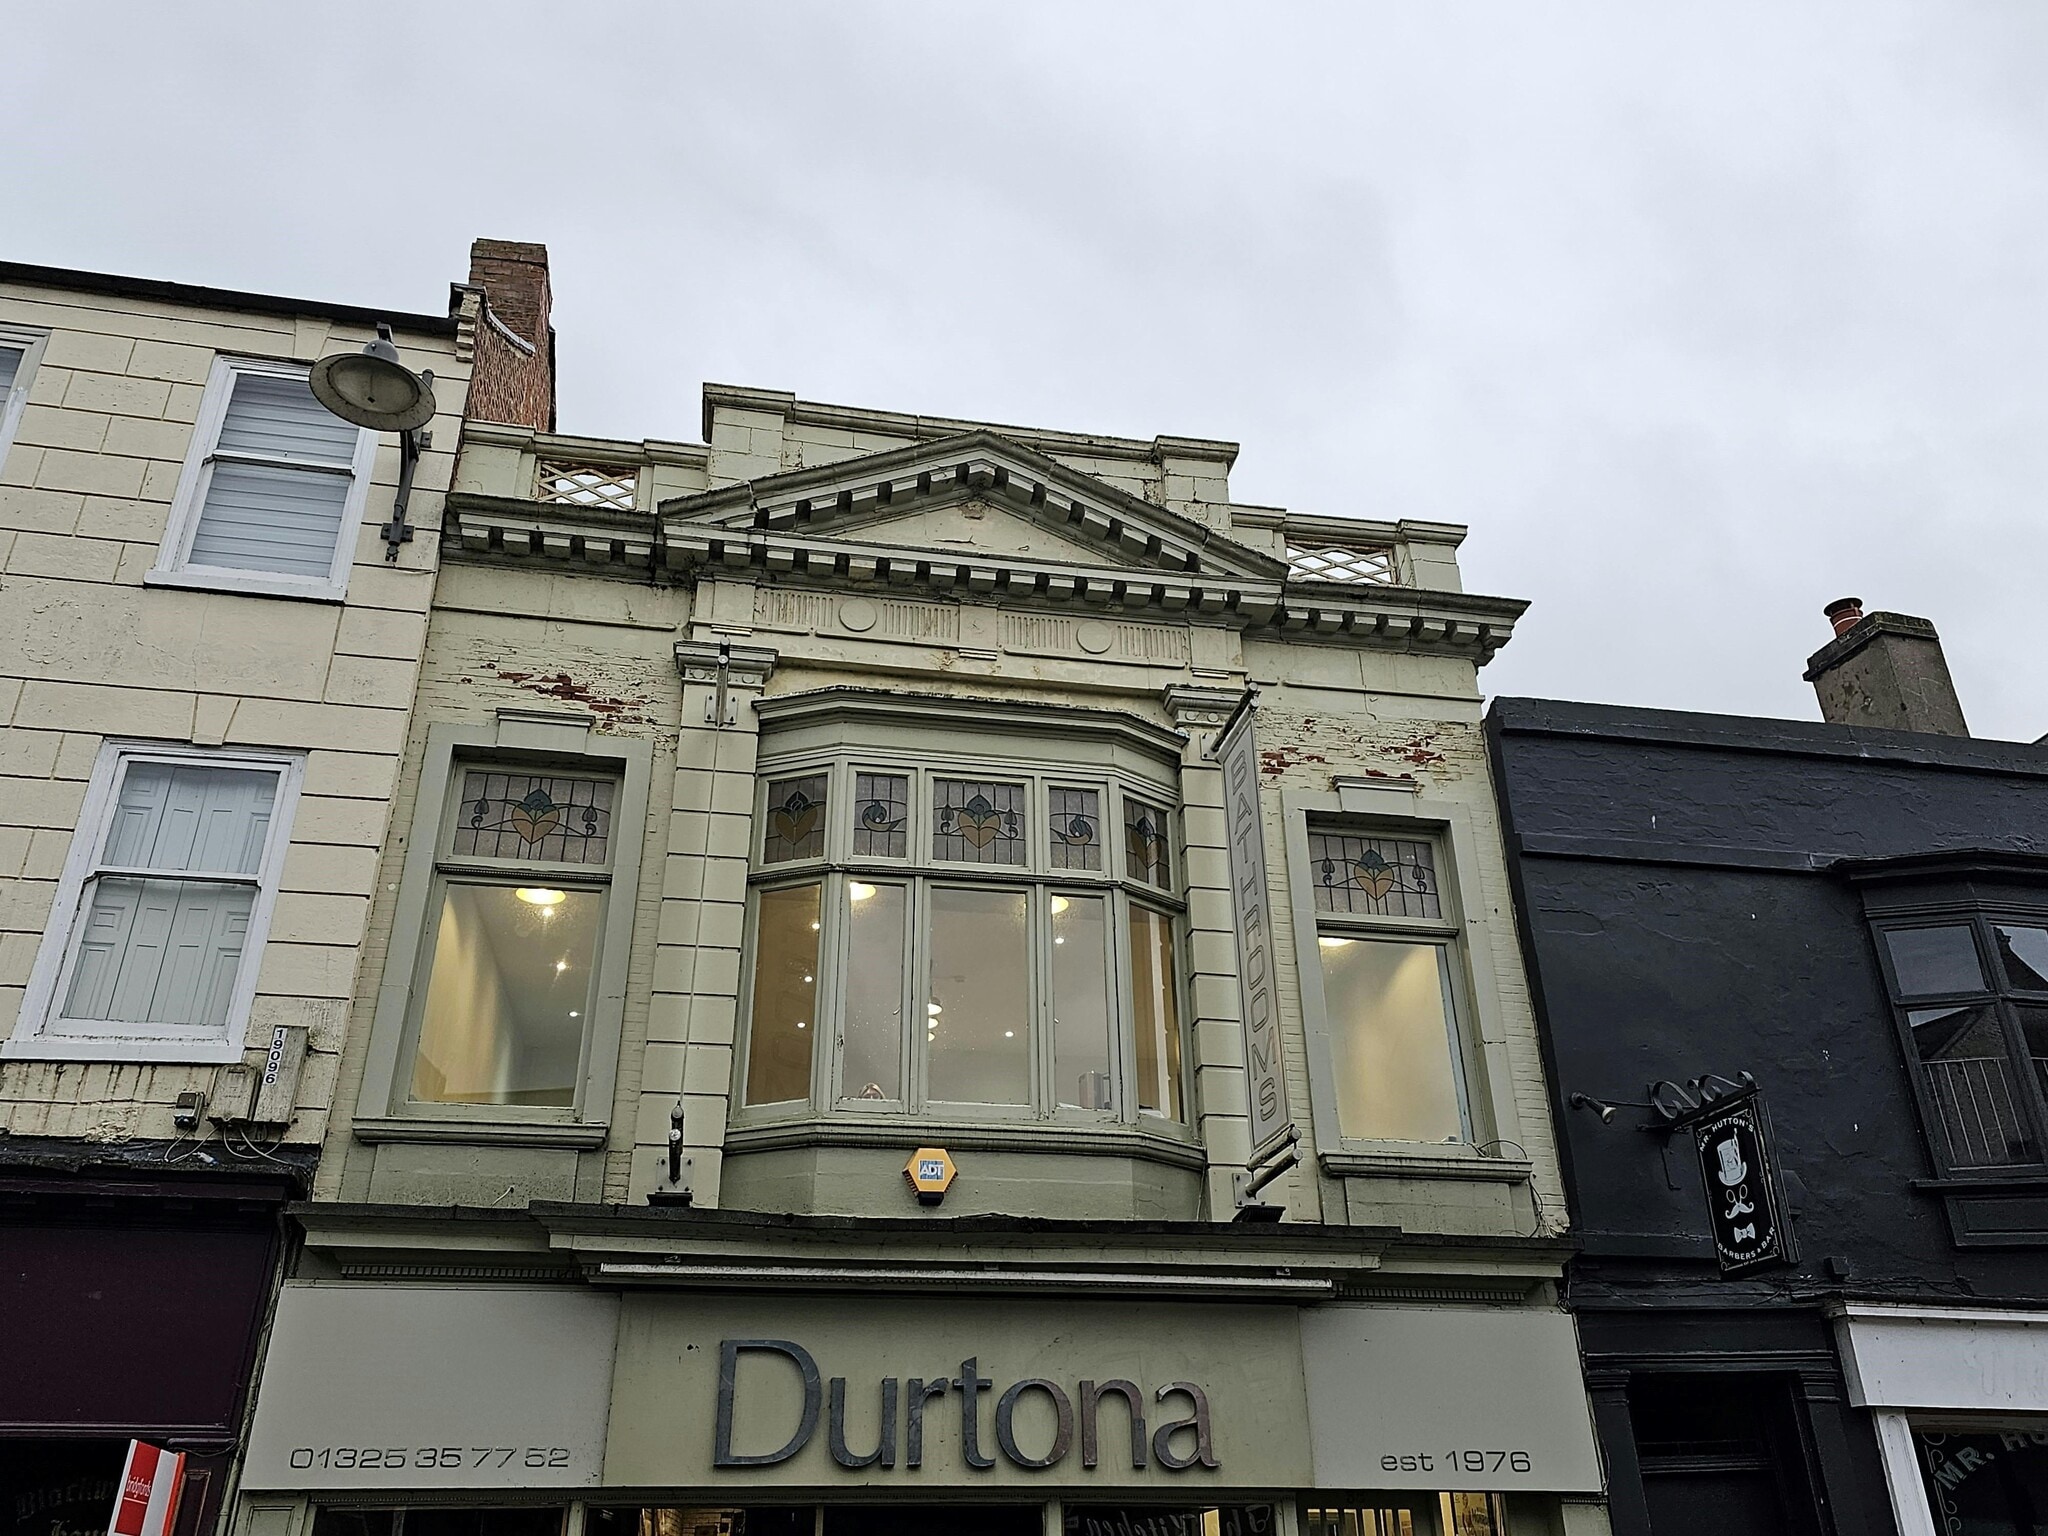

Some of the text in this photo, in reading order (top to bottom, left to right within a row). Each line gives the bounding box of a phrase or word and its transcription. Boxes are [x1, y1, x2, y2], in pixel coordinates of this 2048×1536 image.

[1230, 749, 1277, 1122] BATHROOMS
[265, 1028, 284, 1084] 19096
[1711, 1117, 1754, 1133] HUTTON'S
[920, 1164, 944, 1176] ADT
[1717, 1242, 1756, 1260] BARBERS
[1761, 1226, 1775, 1249] BAR
[713, 1339, 1221, 1469] Durtona
[290, 1448, 570, 1469] 01325 35 77 52
[1381, 1450, 1531, 1473] est 1976
[1934, 1447, 1995, 1490] MR.
